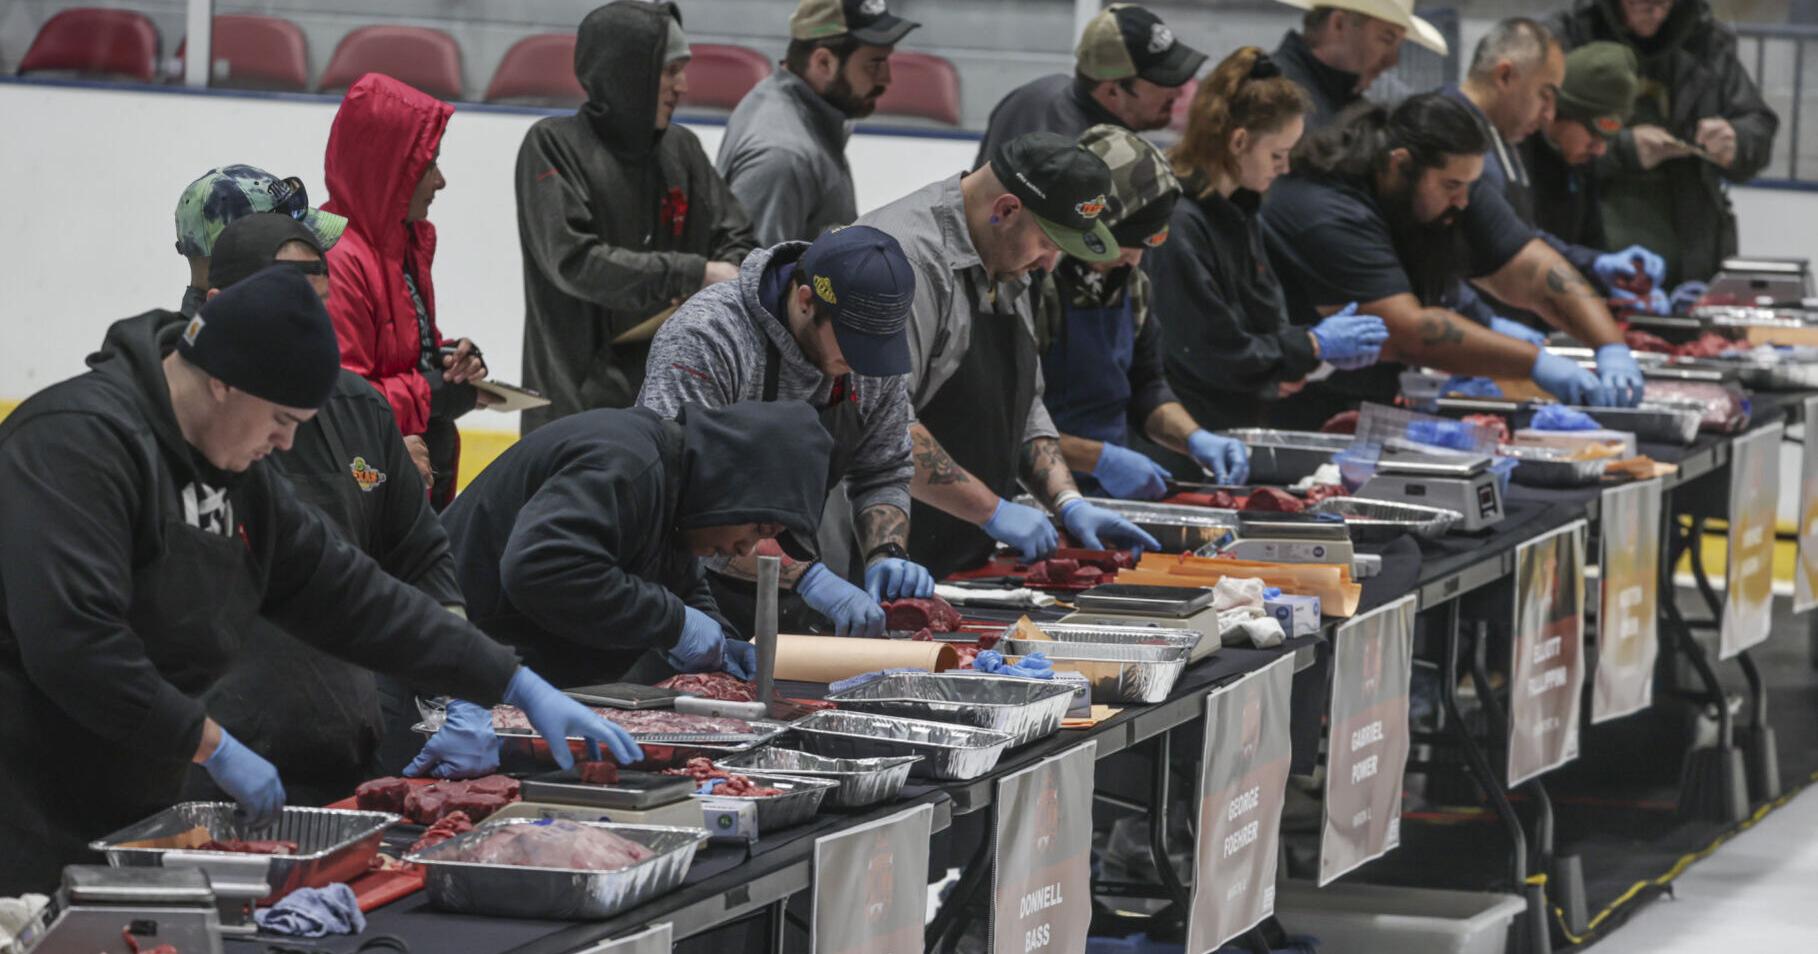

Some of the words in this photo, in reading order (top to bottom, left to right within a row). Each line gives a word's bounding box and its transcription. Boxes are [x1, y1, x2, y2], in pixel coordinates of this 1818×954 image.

[1351, 719, 1384, 752] GABRIEL
[1351, 754, 1379, 785] POWER
[1228, 785, 1260, 821] GEORGE
[1020, 881, 1064, 920] DONNELL
[1025, 922, 1051, 953] BASS
